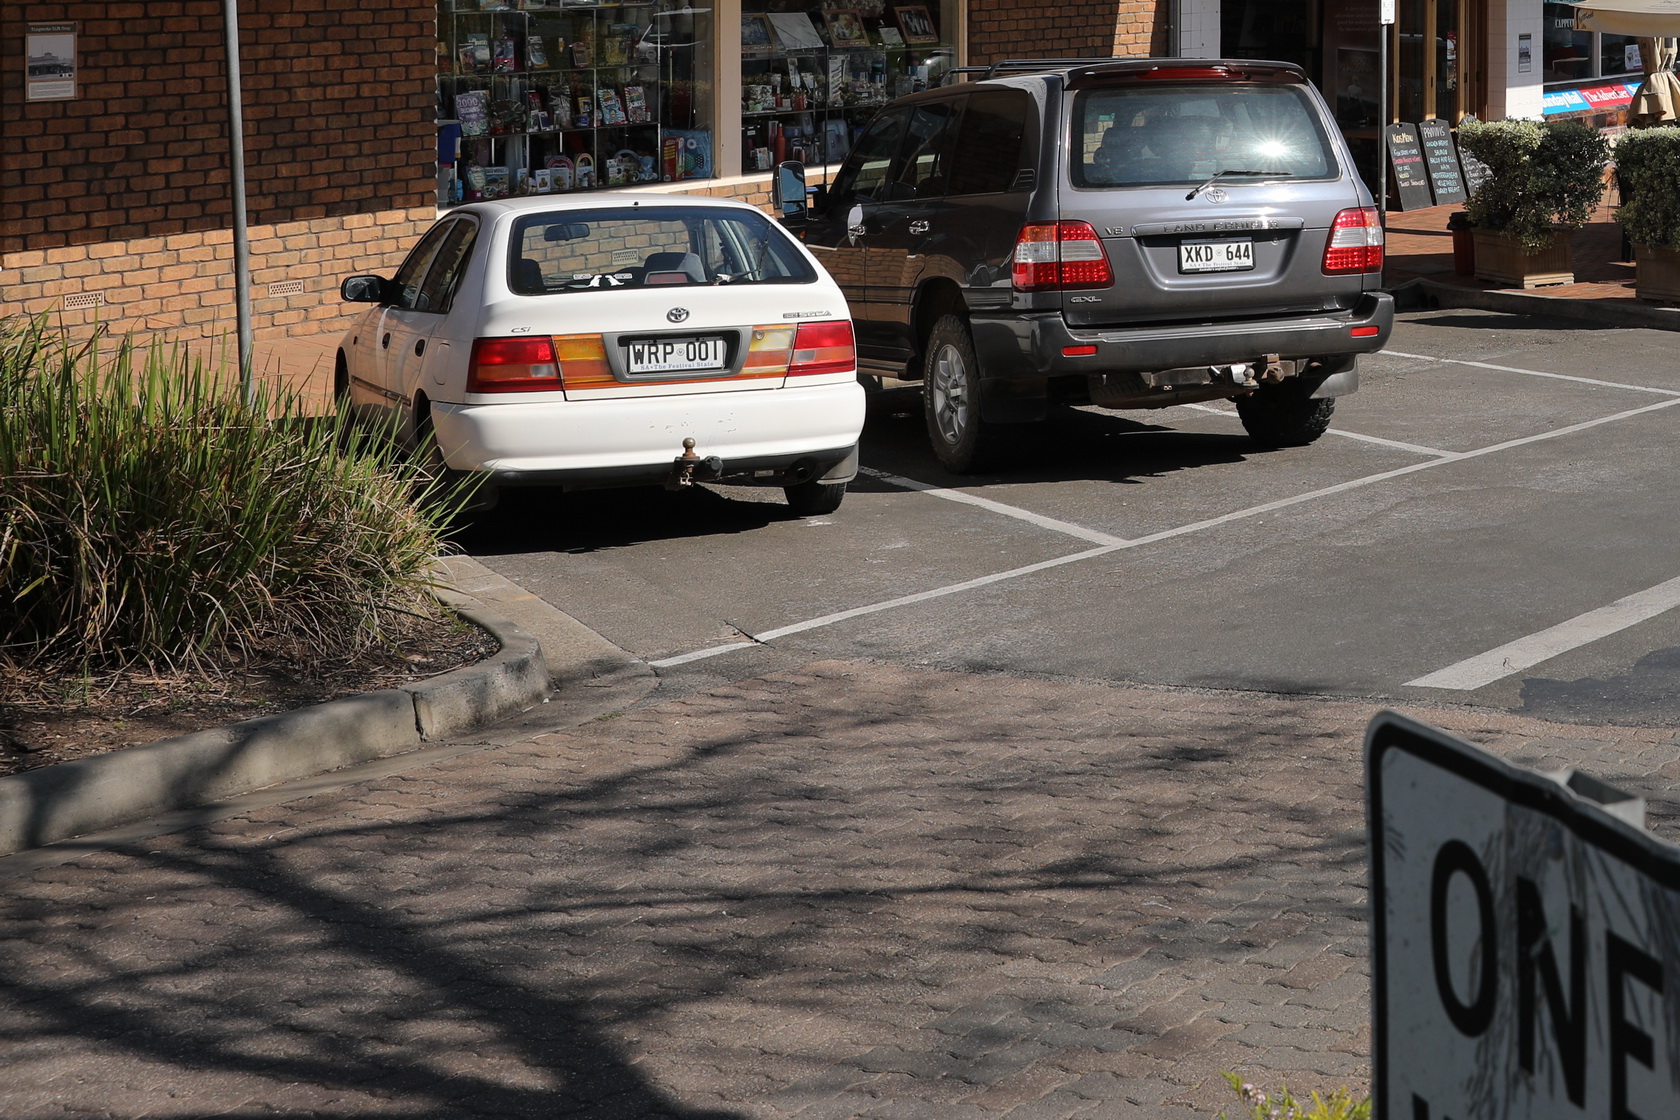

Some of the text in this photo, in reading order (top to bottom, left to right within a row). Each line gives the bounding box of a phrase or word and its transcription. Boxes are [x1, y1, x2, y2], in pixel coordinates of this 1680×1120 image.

[1105, 226, 1124, 235] V8
[1164, 223, 1205, 233] LAND
[1184, 244, 1250, 263] XKD 644
[632, 340, 718, 366] WRP 001
[1431, 839, 1664, 1120] ONE
